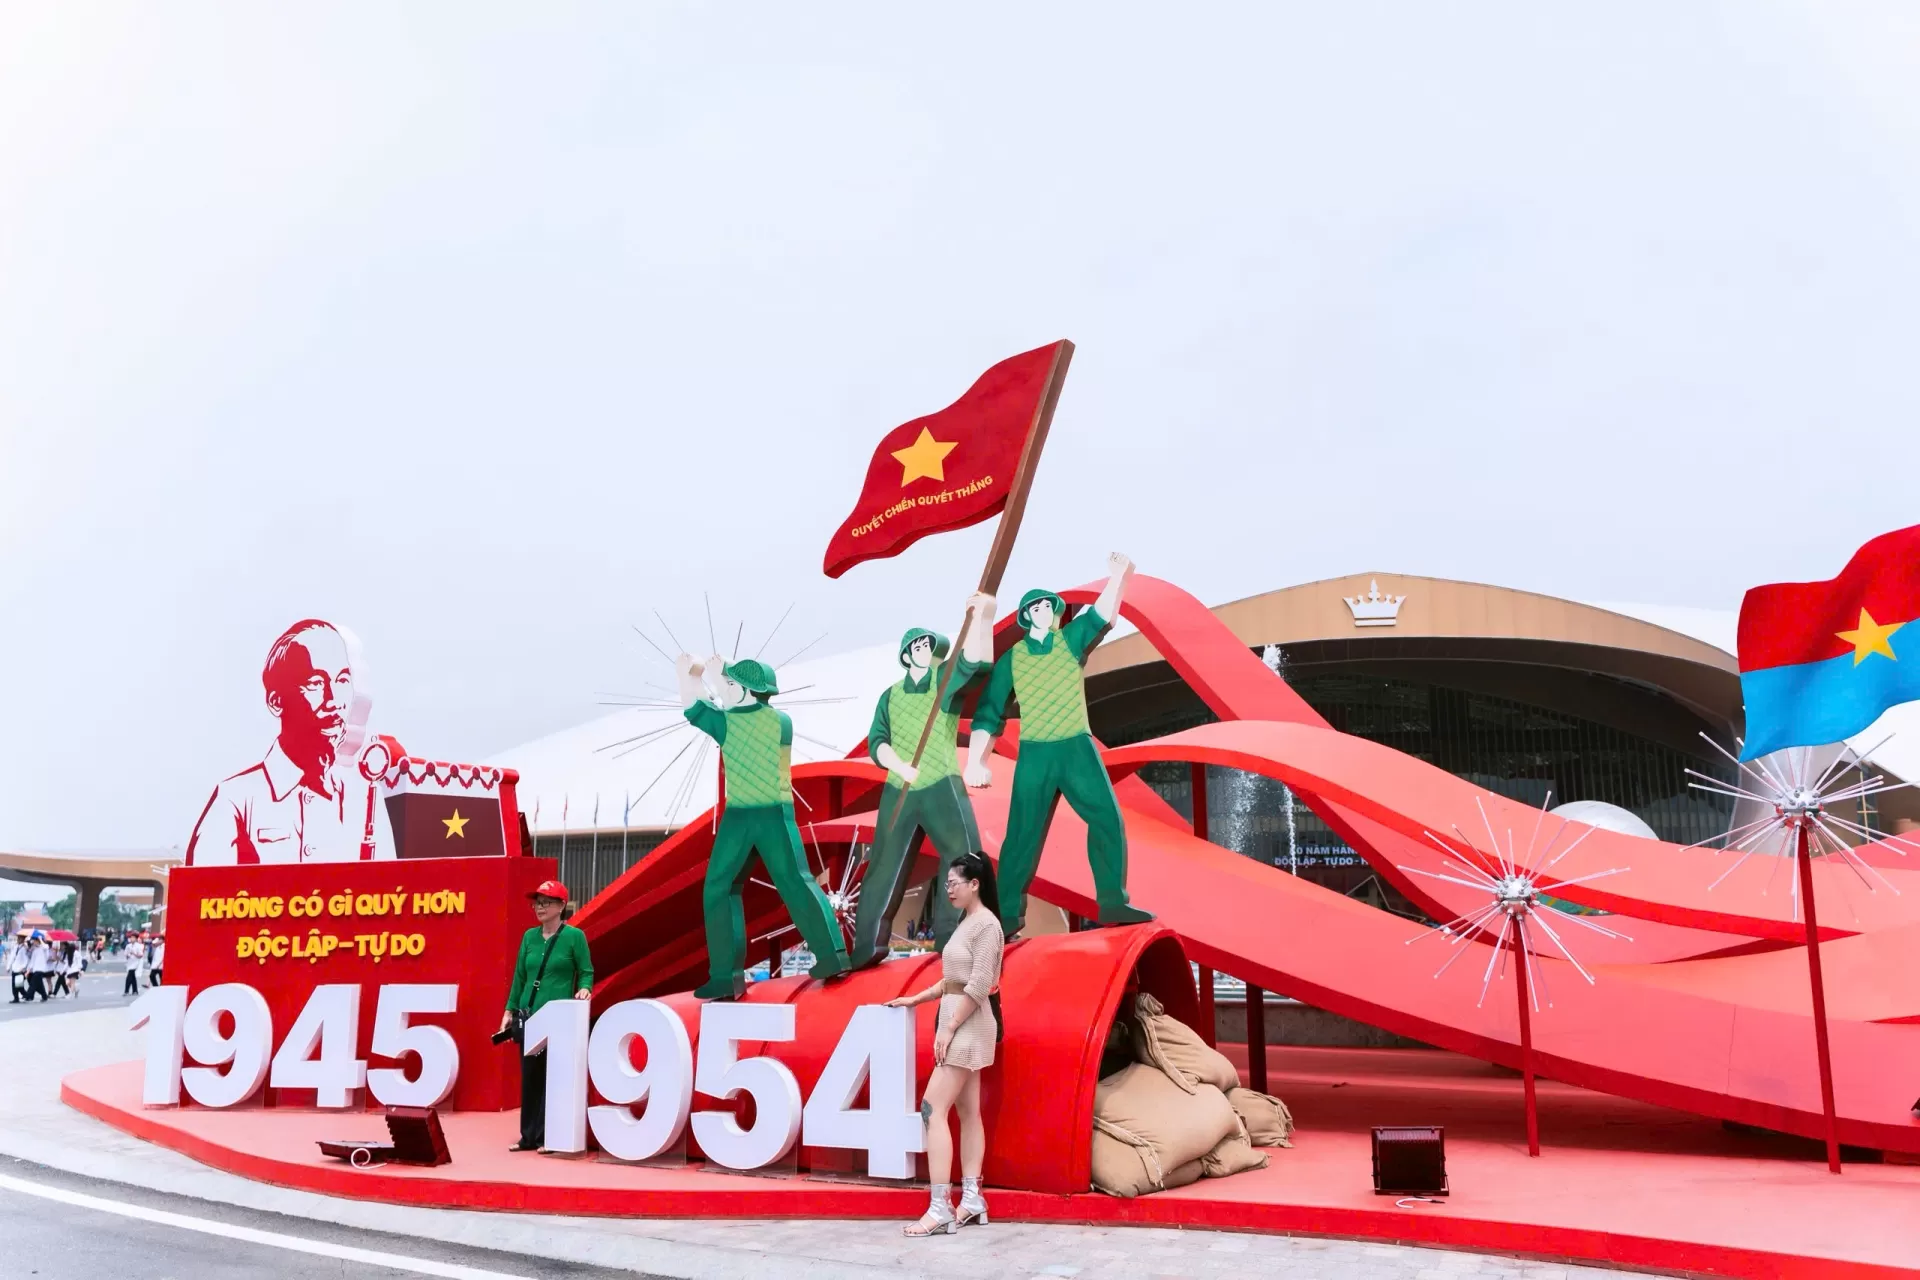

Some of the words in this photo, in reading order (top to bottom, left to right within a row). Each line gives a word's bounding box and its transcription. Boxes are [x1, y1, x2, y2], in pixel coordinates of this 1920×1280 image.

[851, 513, 885, 538] QUYẾT
[884, 497, 916, 519] CHIẾN
[917, 489, 955, 506] QUYẾT
[955, 475, 993, 499] THẮNG
[1332, 843, 1358, 855] HÀN
[1339, 857, 1354, 865] DO
[201, 891, 284, 919] KHÔNG
[288, 889, 323, 917] CÓ
[329, 889, 352, 916] GÌ
[355, 886, 407, 915] QUÝ
[412, 889, 466, 914] HƠN
[236, 929, 289, 964] ĐỘC
[390, 934, 426, 956] DO
[129, 983, 460, 1108] 1945
[523, 998, 927, 1180] 1954
